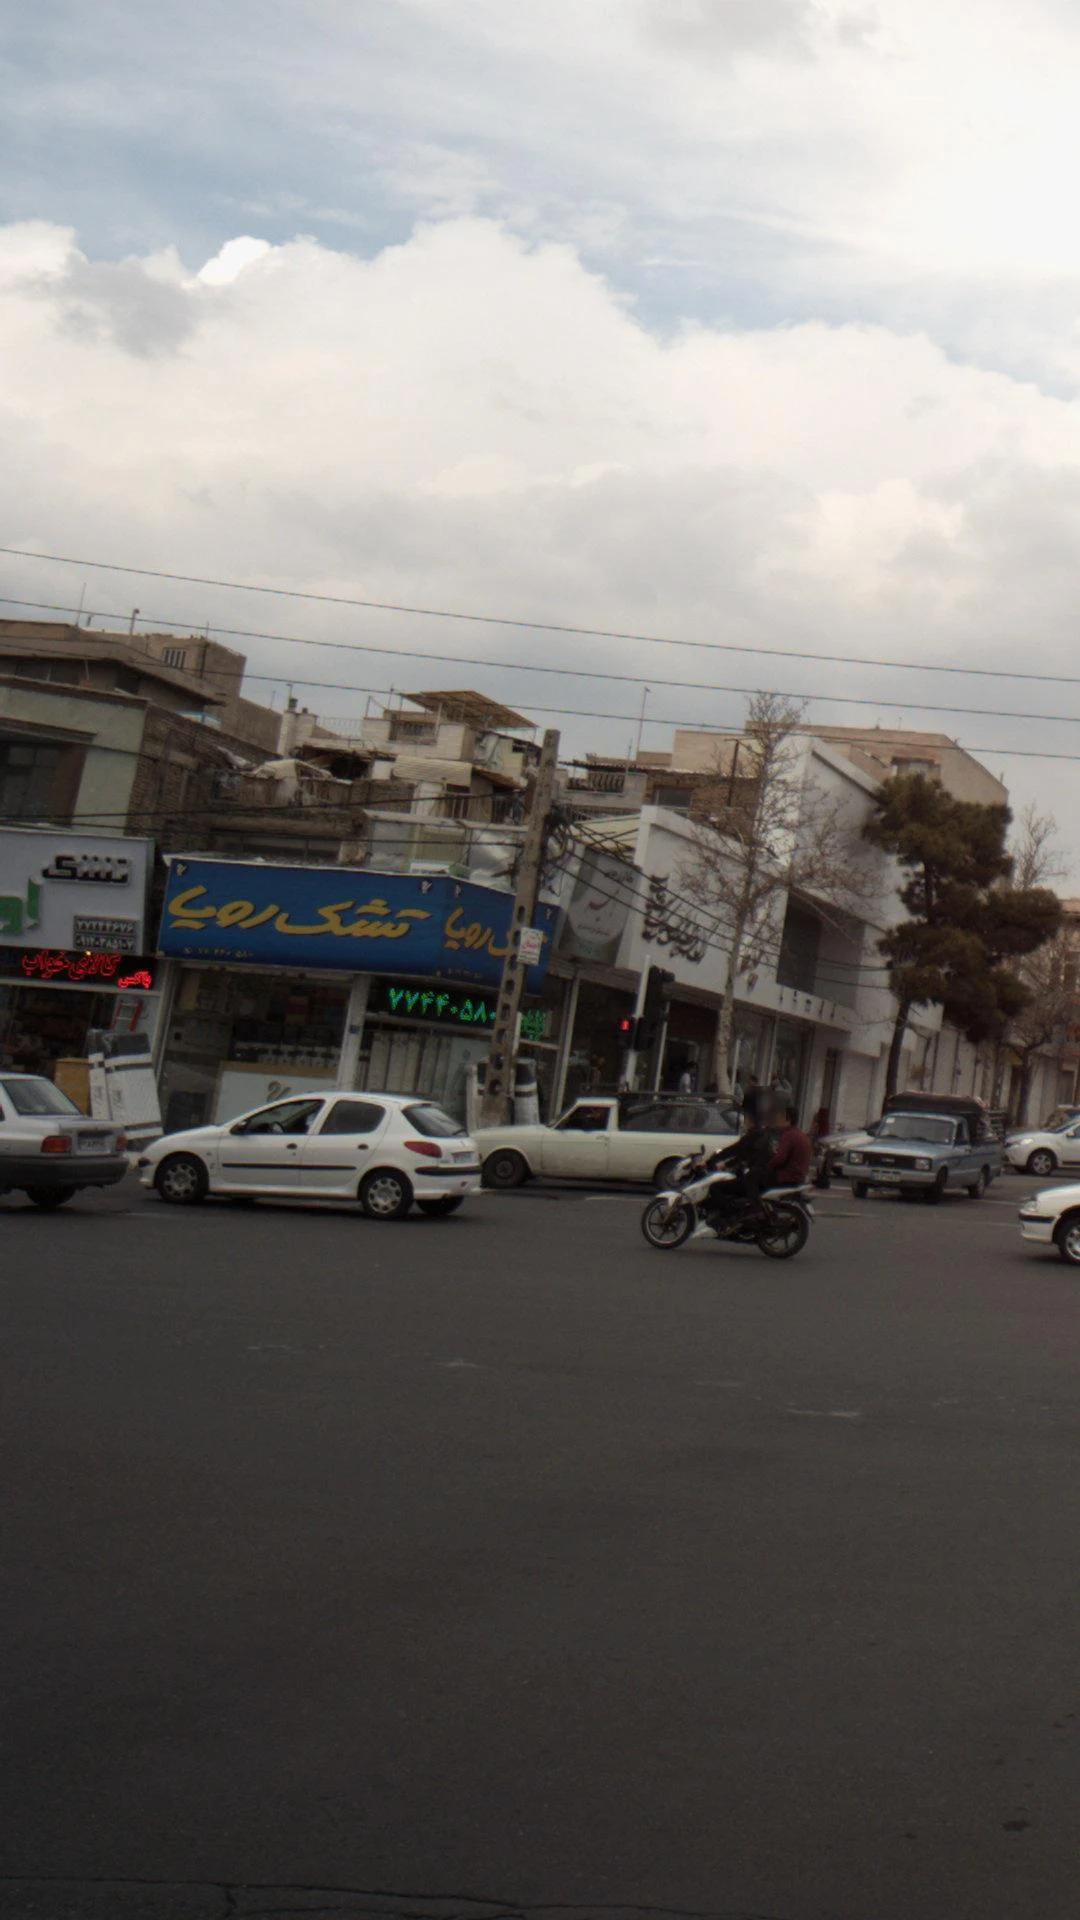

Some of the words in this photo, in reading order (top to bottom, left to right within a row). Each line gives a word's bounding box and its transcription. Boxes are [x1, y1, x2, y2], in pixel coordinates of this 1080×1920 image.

[42, 855, 128, 884] تشک
[167, 885, 281, 931] رویا
[275, 899, 433, 940] تشک
